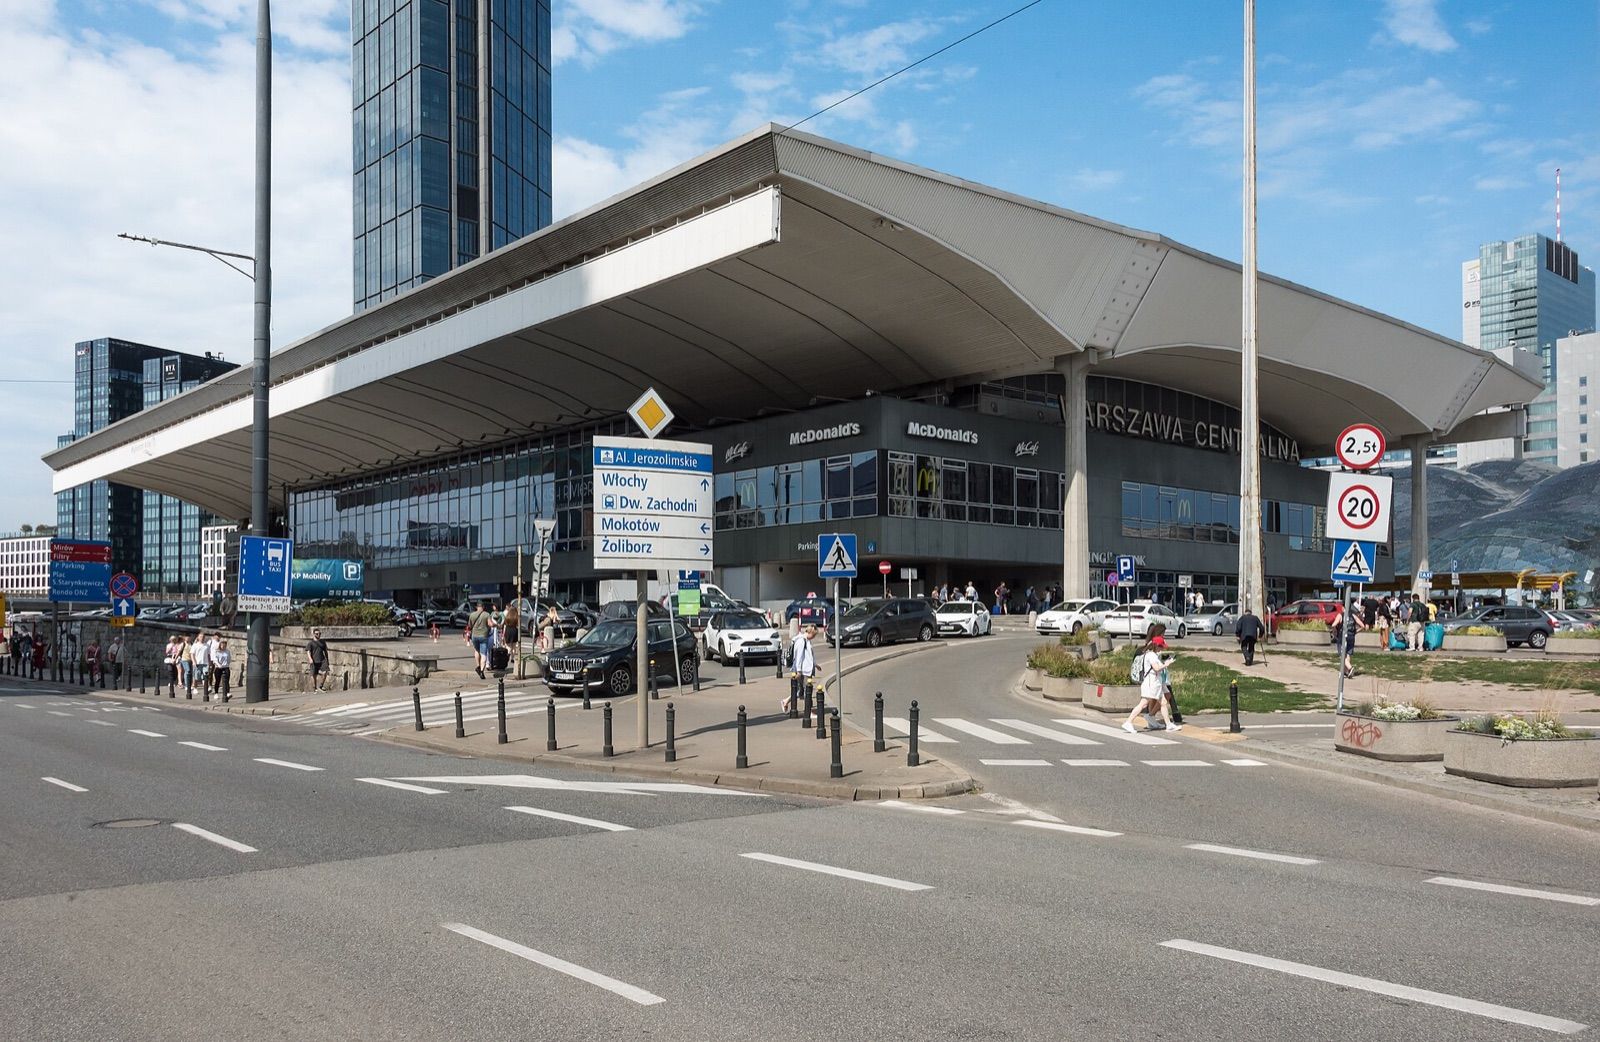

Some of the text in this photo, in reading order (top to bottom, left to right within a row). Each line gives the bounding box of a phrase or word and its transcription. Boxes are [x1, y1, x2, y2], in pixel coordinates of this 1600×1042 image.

[789, 422, 860, 445] McDonald's
[907, 421, 978, 444] McDonald's
[1195, 421, 1299, 460] CENTALNA
[1345, 437, 1377, 455] 2,5t
[615, 450, 698, 468] Al. Jerozolimskie
[602, 473, 648, 491] Włochy
[620, 496, 697, 512] Dw. Zachodni
[1347, 497, 1373, 518] 20
[602, 518, 660, 532] Mokotów
[602, 535, 652, 553] Żoliborz
[347, 565, 357, 577] P
[1120, 558, 1131, 574] P
[302, 572, 331, 582] Mobility
